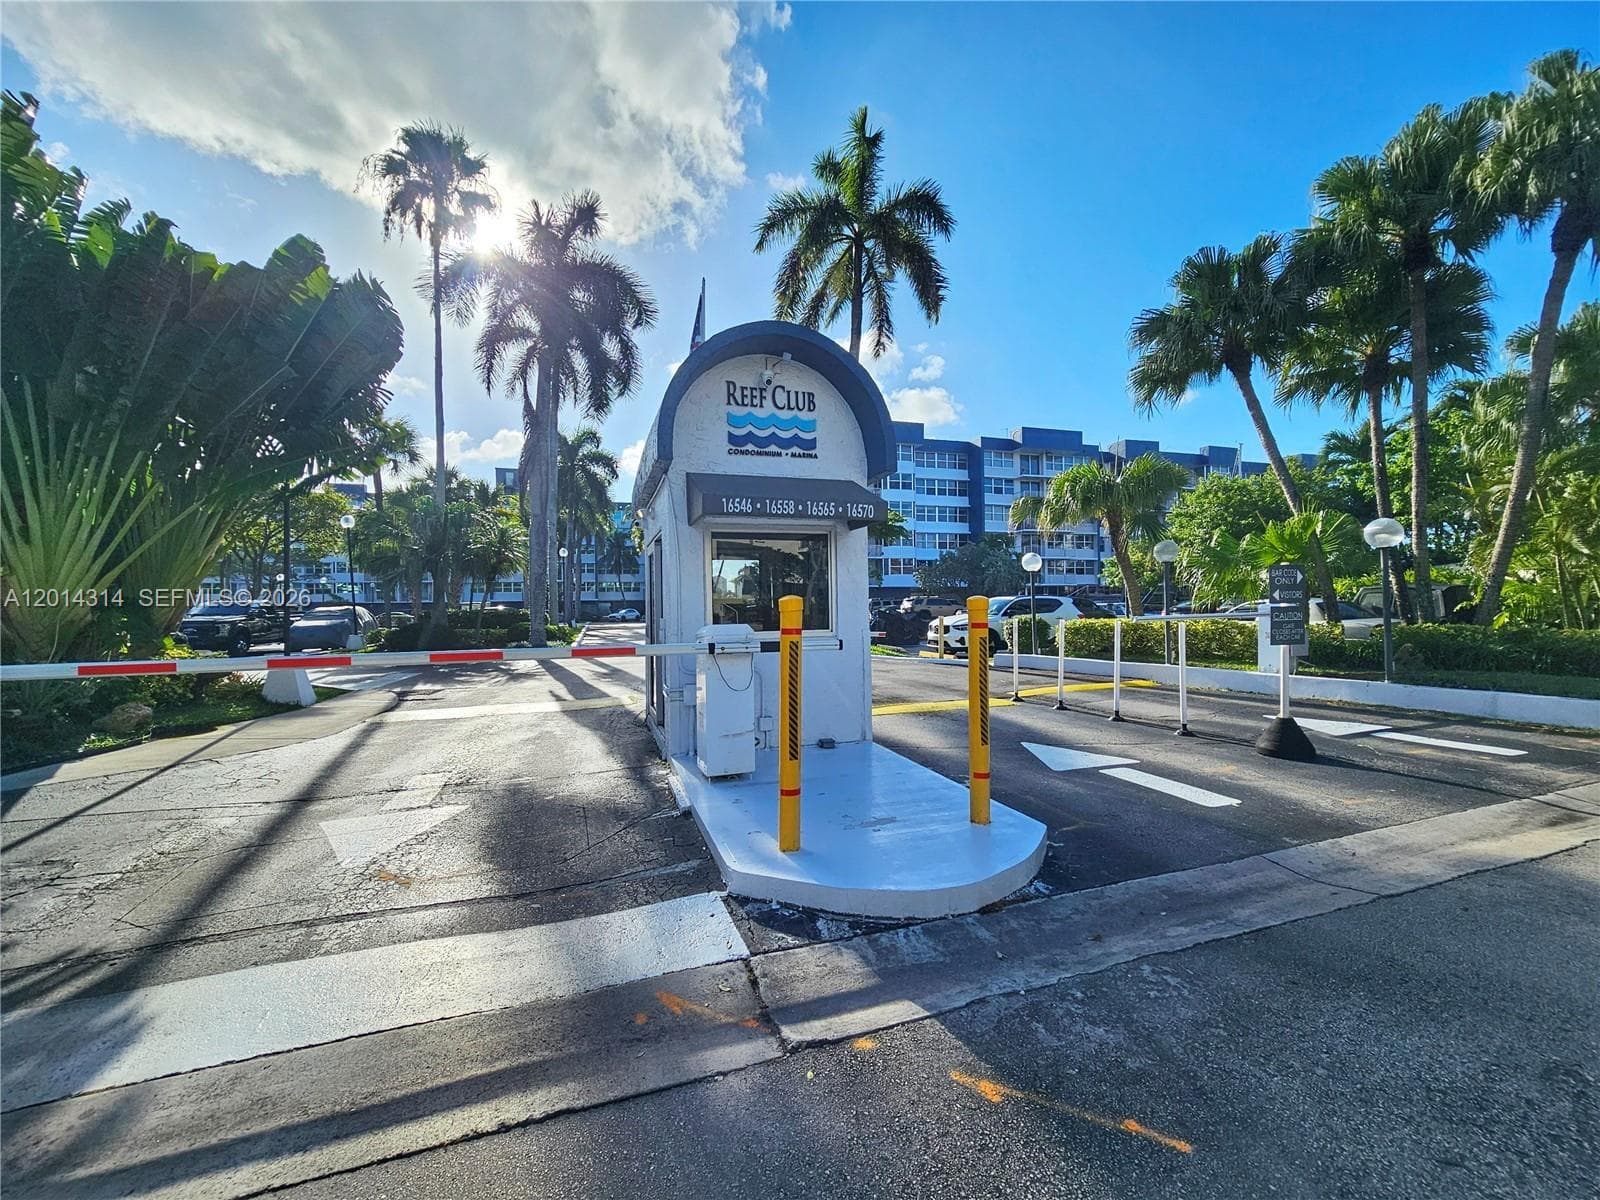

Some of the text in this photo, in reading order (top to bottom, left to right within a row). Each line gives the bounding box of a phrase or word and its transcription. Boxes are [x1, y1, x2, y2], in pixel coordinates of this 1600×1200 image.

[725, 380, 816, 412] REEF CLUB
[727, 448, 818, 459] CONDOMINIUM MARINA
[722, 498, 874, 518] 16546 16558 16565 16570
[1284, 569, 1297, 577] CODE
[1274, 577, 1295, 585] ONLY
[1280, 590, 1303, 599] VISITORS
[1273, 611, 1303, 619] CAUTION
